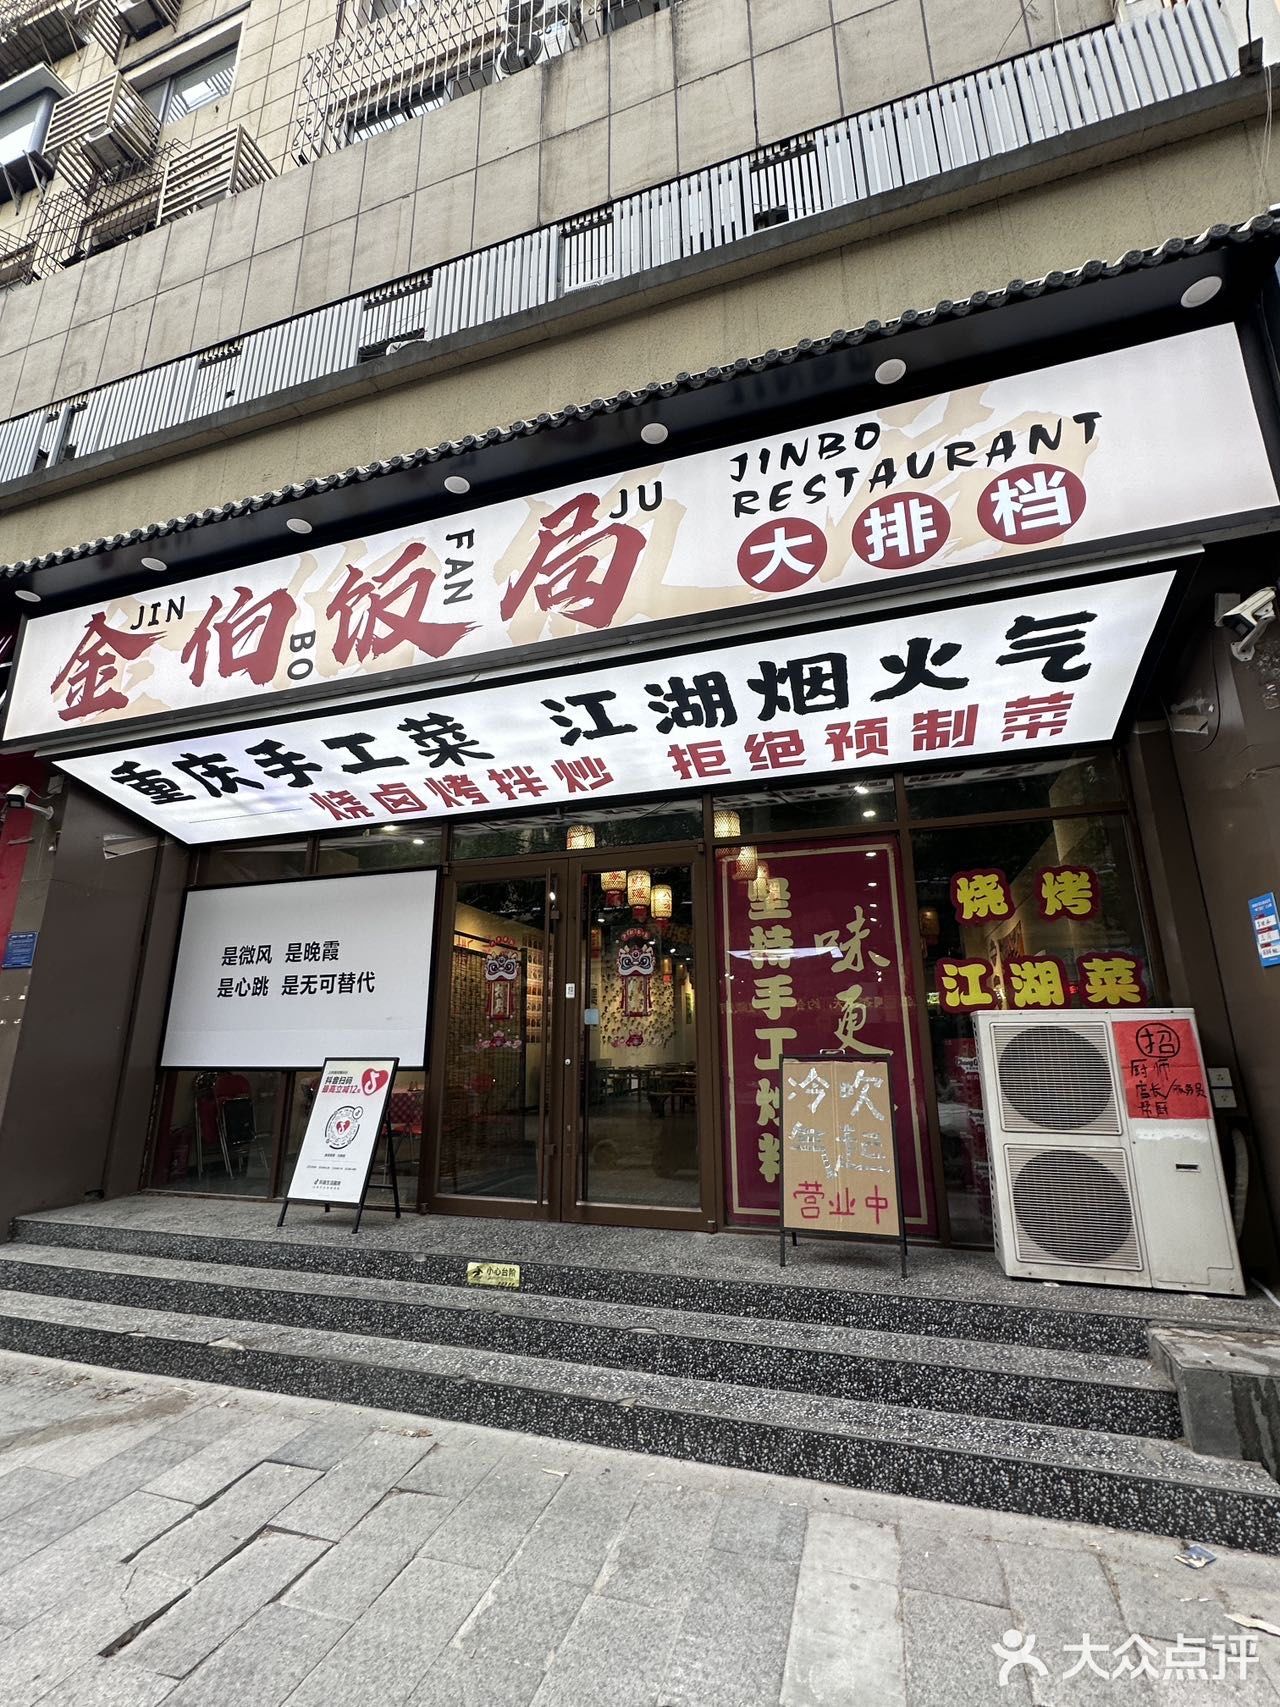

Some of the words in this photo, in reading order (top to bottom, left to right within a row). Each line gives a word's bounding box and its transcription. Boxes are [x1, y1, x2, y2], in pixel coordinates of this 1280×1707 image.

[730, 422, 881, 482] JINBO
[733, 411, 1102, 519] RESTAURANT
[609, 481, 663, 519] JU
[750, 471, 1073, 585] 大排档
[443, 528, 476, 606] FAN
[51, 493, 647, 722] 金伯饭局
[130, 596, 185, 630] JIN
[287, 630, 315, 680] BO
[110, 713, 496, 805] 重庆手工菜
[541, 611, 1098, 747] 江湖烟火气
[309, 755, 615, 821] 烧卤烤拌炒
[667, 691, 1075, 780] 拒绝预制菜
[957, 871, 1093, 919] 烧烤
[221, 944, 272, 966] 是微风
[285, 940, 340, 963] 是晚霞
[217, 976, 269, 998] 是心跳
[281, 971, 375, 996] 是无可替代
[942, 957, 1141, 1008] 江湖菜
[1140, 1028, 1175, 1054] 招
[1131, 1059, 1170, 1080] 厨师
[793, 1180, 888, 1225] 营业中
[487, 1267, 517, 1277] 小心台阶
